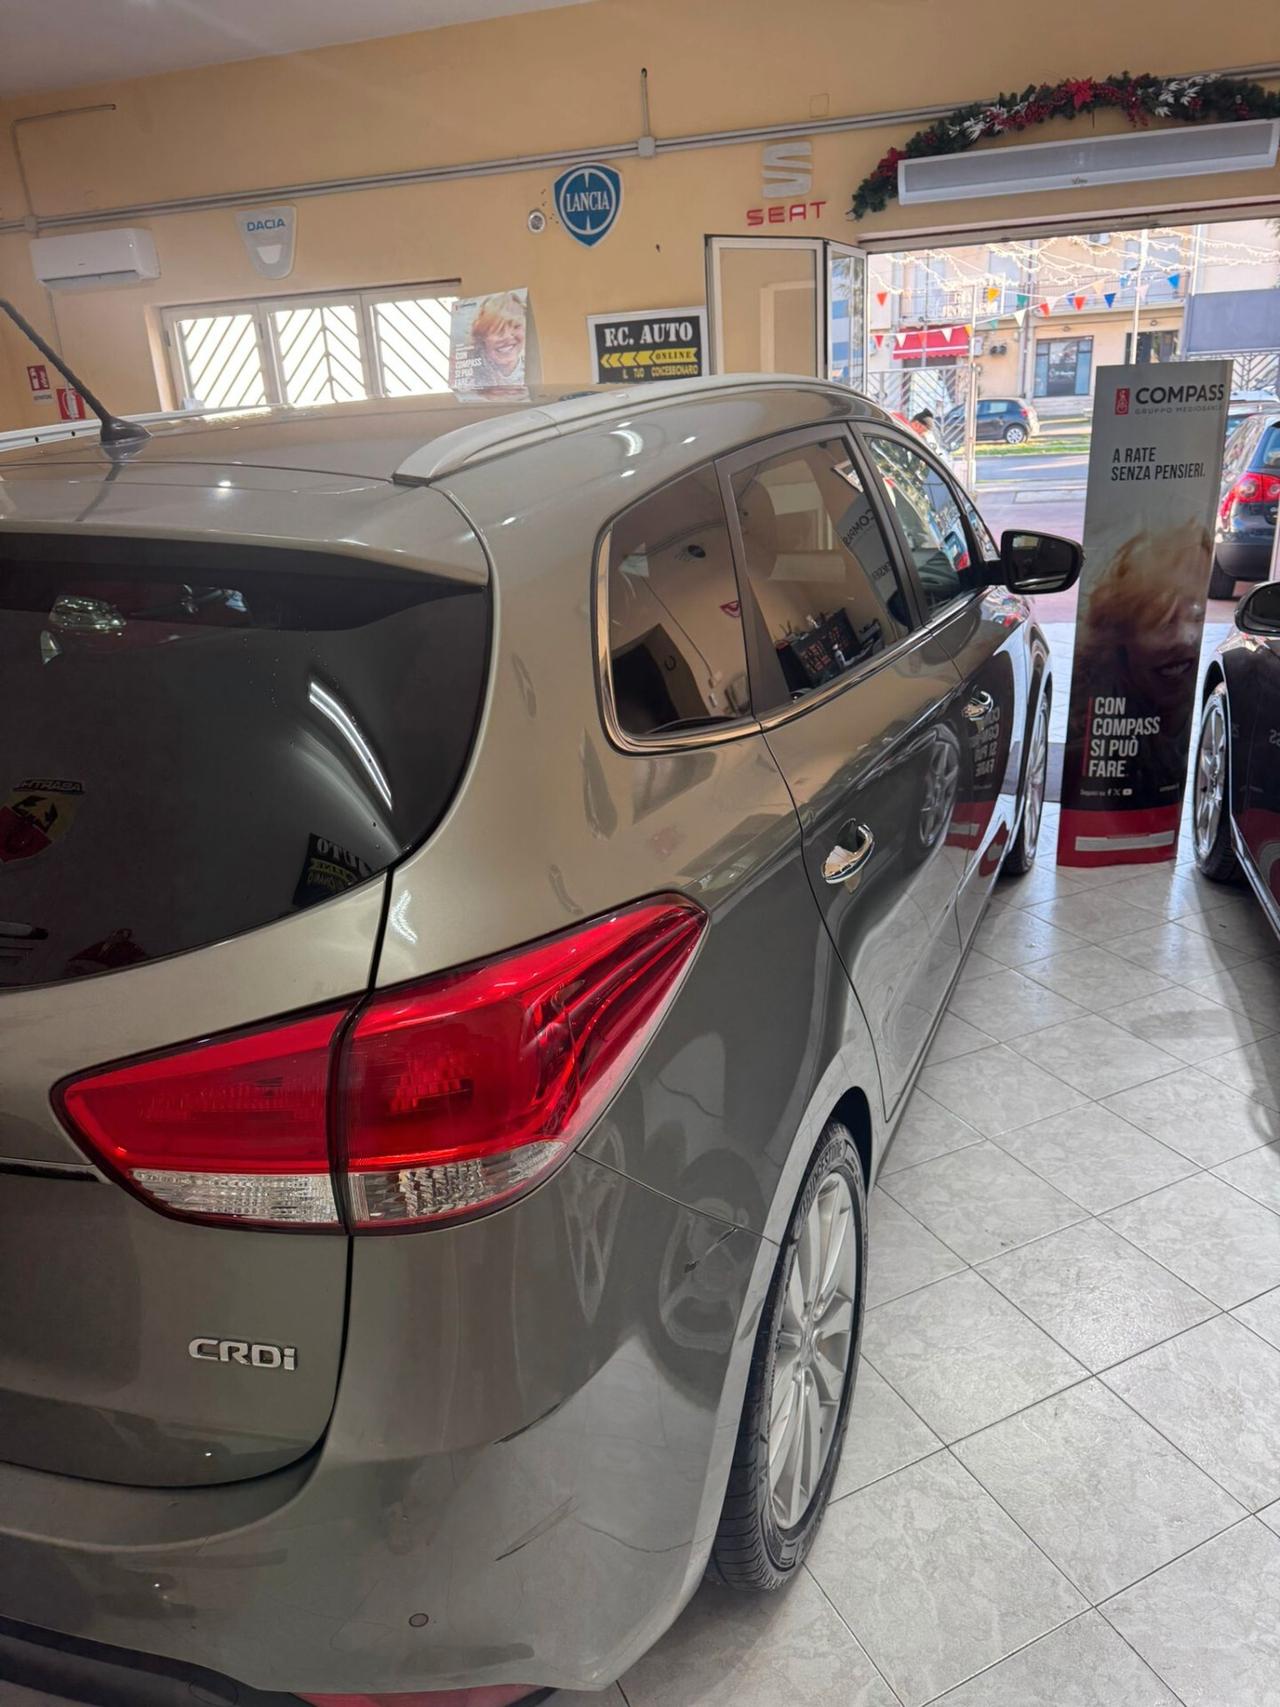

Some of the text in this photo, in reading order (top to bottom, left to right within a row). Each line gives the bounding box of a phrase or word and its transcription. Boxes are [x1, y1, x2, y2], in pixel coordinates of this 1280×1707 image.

[566, 191, 609, 212] LANCIA
[746, 201, 827, 226] SEAT
[247, 218, 286, 231] DACIA
[640, 322, 693, 344] AUTO
[655, 351, 692, 360] ONLINE
[1135, 384, 1225, 405] COMPASS
[1112, 447, 1156, 463] A RATE
[1111, 462, 1205, 481] SENZA PENSIERI.
[1094, 697, 1126, 715] CON
[1092, 716, 1160, 736] COMPASS
[1090, 735, 1138, 757] SI PUÒ
[188, 1338, 296, 1371] CRDi
